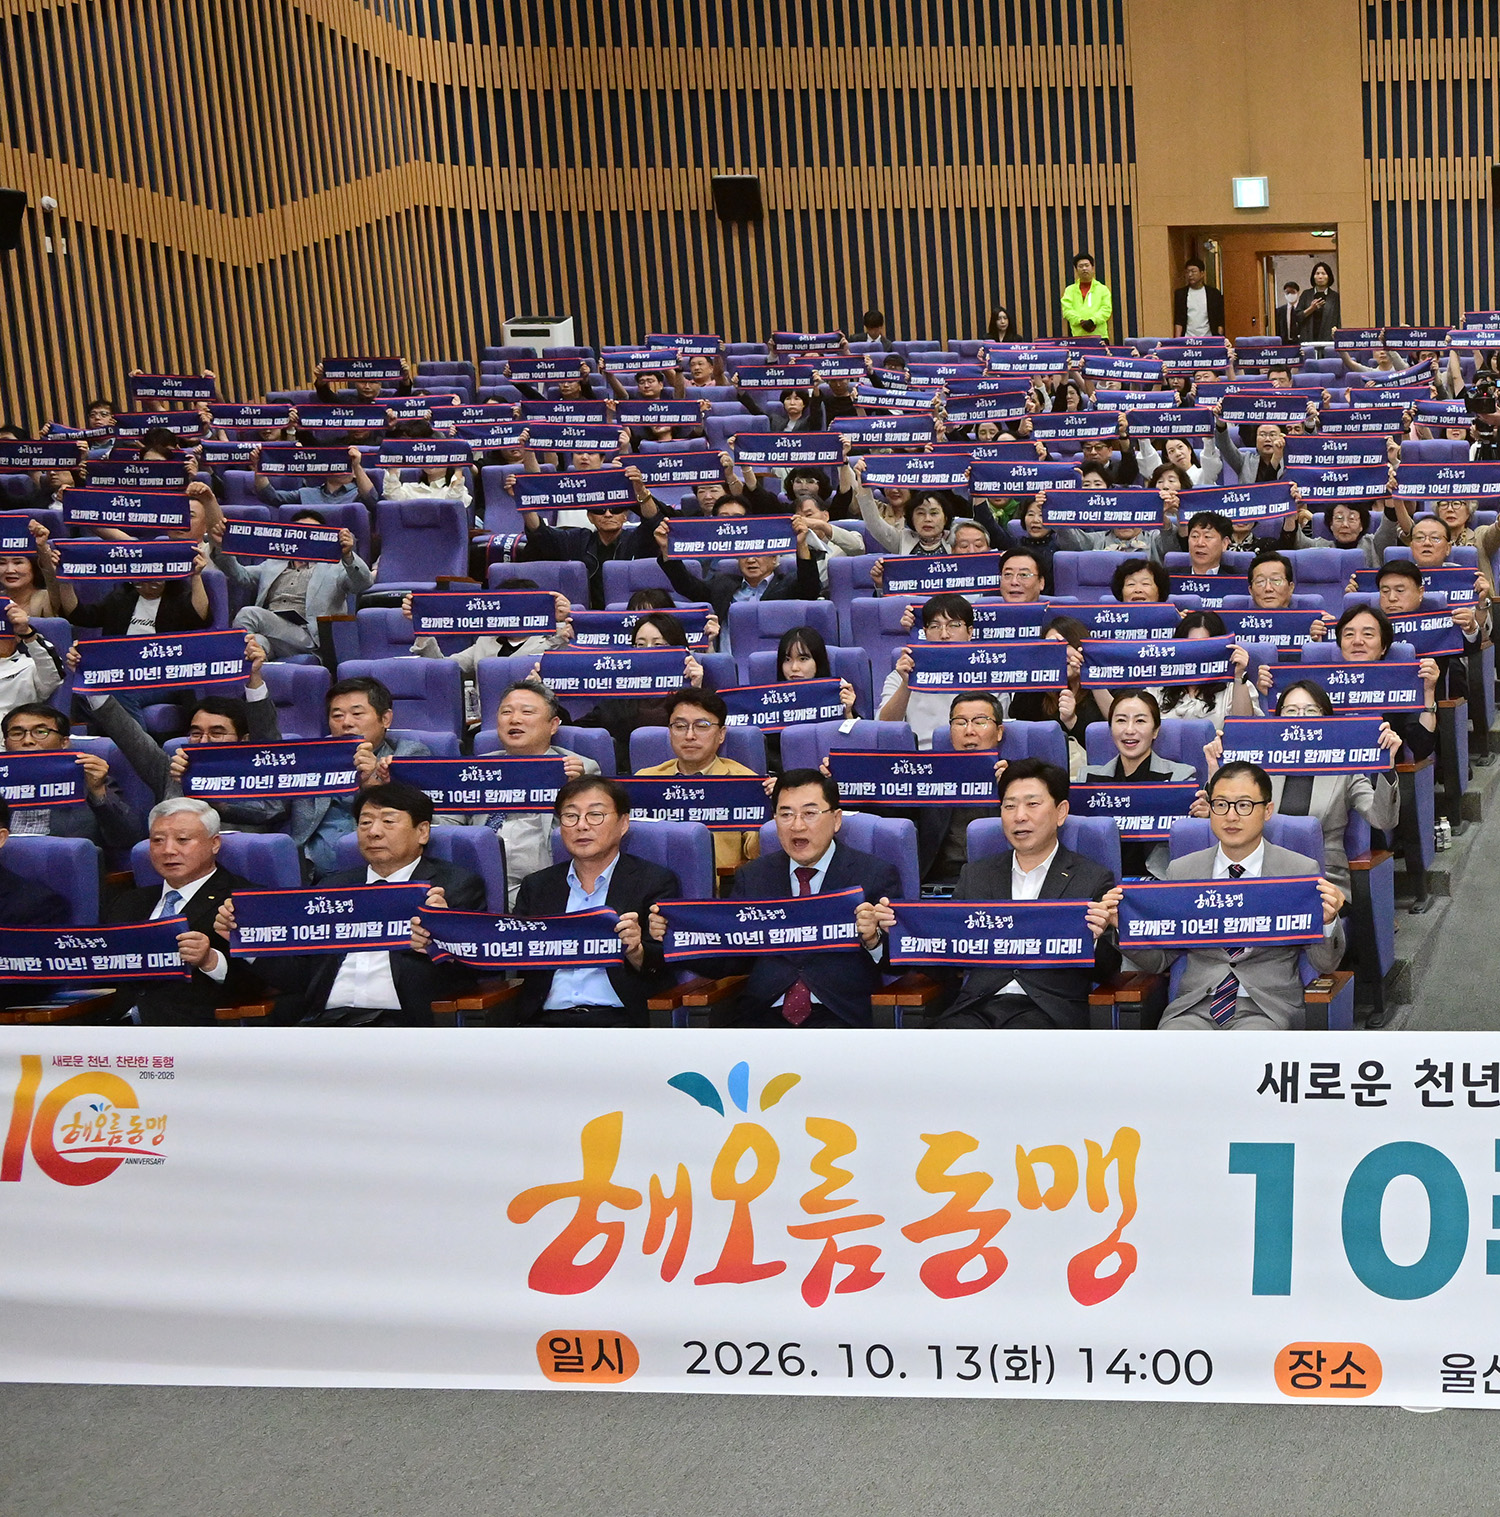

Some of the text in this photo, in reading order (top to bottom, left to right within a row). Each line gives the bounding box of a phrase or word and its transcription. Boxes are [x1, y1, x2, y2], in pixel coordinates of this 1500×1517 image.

[1398, 485, 1425, 494] 함께한
[1429, 485, 1450, 493] 10년!
[1453, 484, 1480, 493] 함께할
[1048, 511, 1156, 521] 함께한 10년! 함께할 미래!
[674, 538, 790, 552] 함께한 10년! 함께할 미래!
[421, 616, 548, 628] 함께한 10년! 함께할 미래!
[84, 660, 242, 684] 함께한 10년! 함께할 미래!
[917, 670, 1059, 684] 함께한 10년! 함께할 미래!
[240, 926, 287, 942] 함께한
[292, 924, 330, 940] 10년!
[335, 922, 383, 939] 함께할
[1129, 914, 1311, 936] 함께한 10년! 함께할 미래!
[674, 922, 859, 947] 함께한 10년! 함께할 미래!
[482, 942, 522, 957] 10년!
[528, 940, 579, 956] 함께할
[584, 939, 622, 954] 미래!
[901, 937, 1082, 954] 함께한 10년! 함께할 미래!
[46, 957, 87, 970] 10년!
[91, 954, 142, 969] 함께할
[52, 1056, 83, 1068] 새로운
[116, 1056, 148, 1068] 찬란한
[152, 1056, 174, 1068] 동행
[1257, 1061, 1391, 1107] 새로운
[555, 1337, 623, 1374] 일시
[683, 1340, 1213, 1386] 2026. 10. 13(화) 14:00
[1289, 1350, 1367, 1390] 장소
